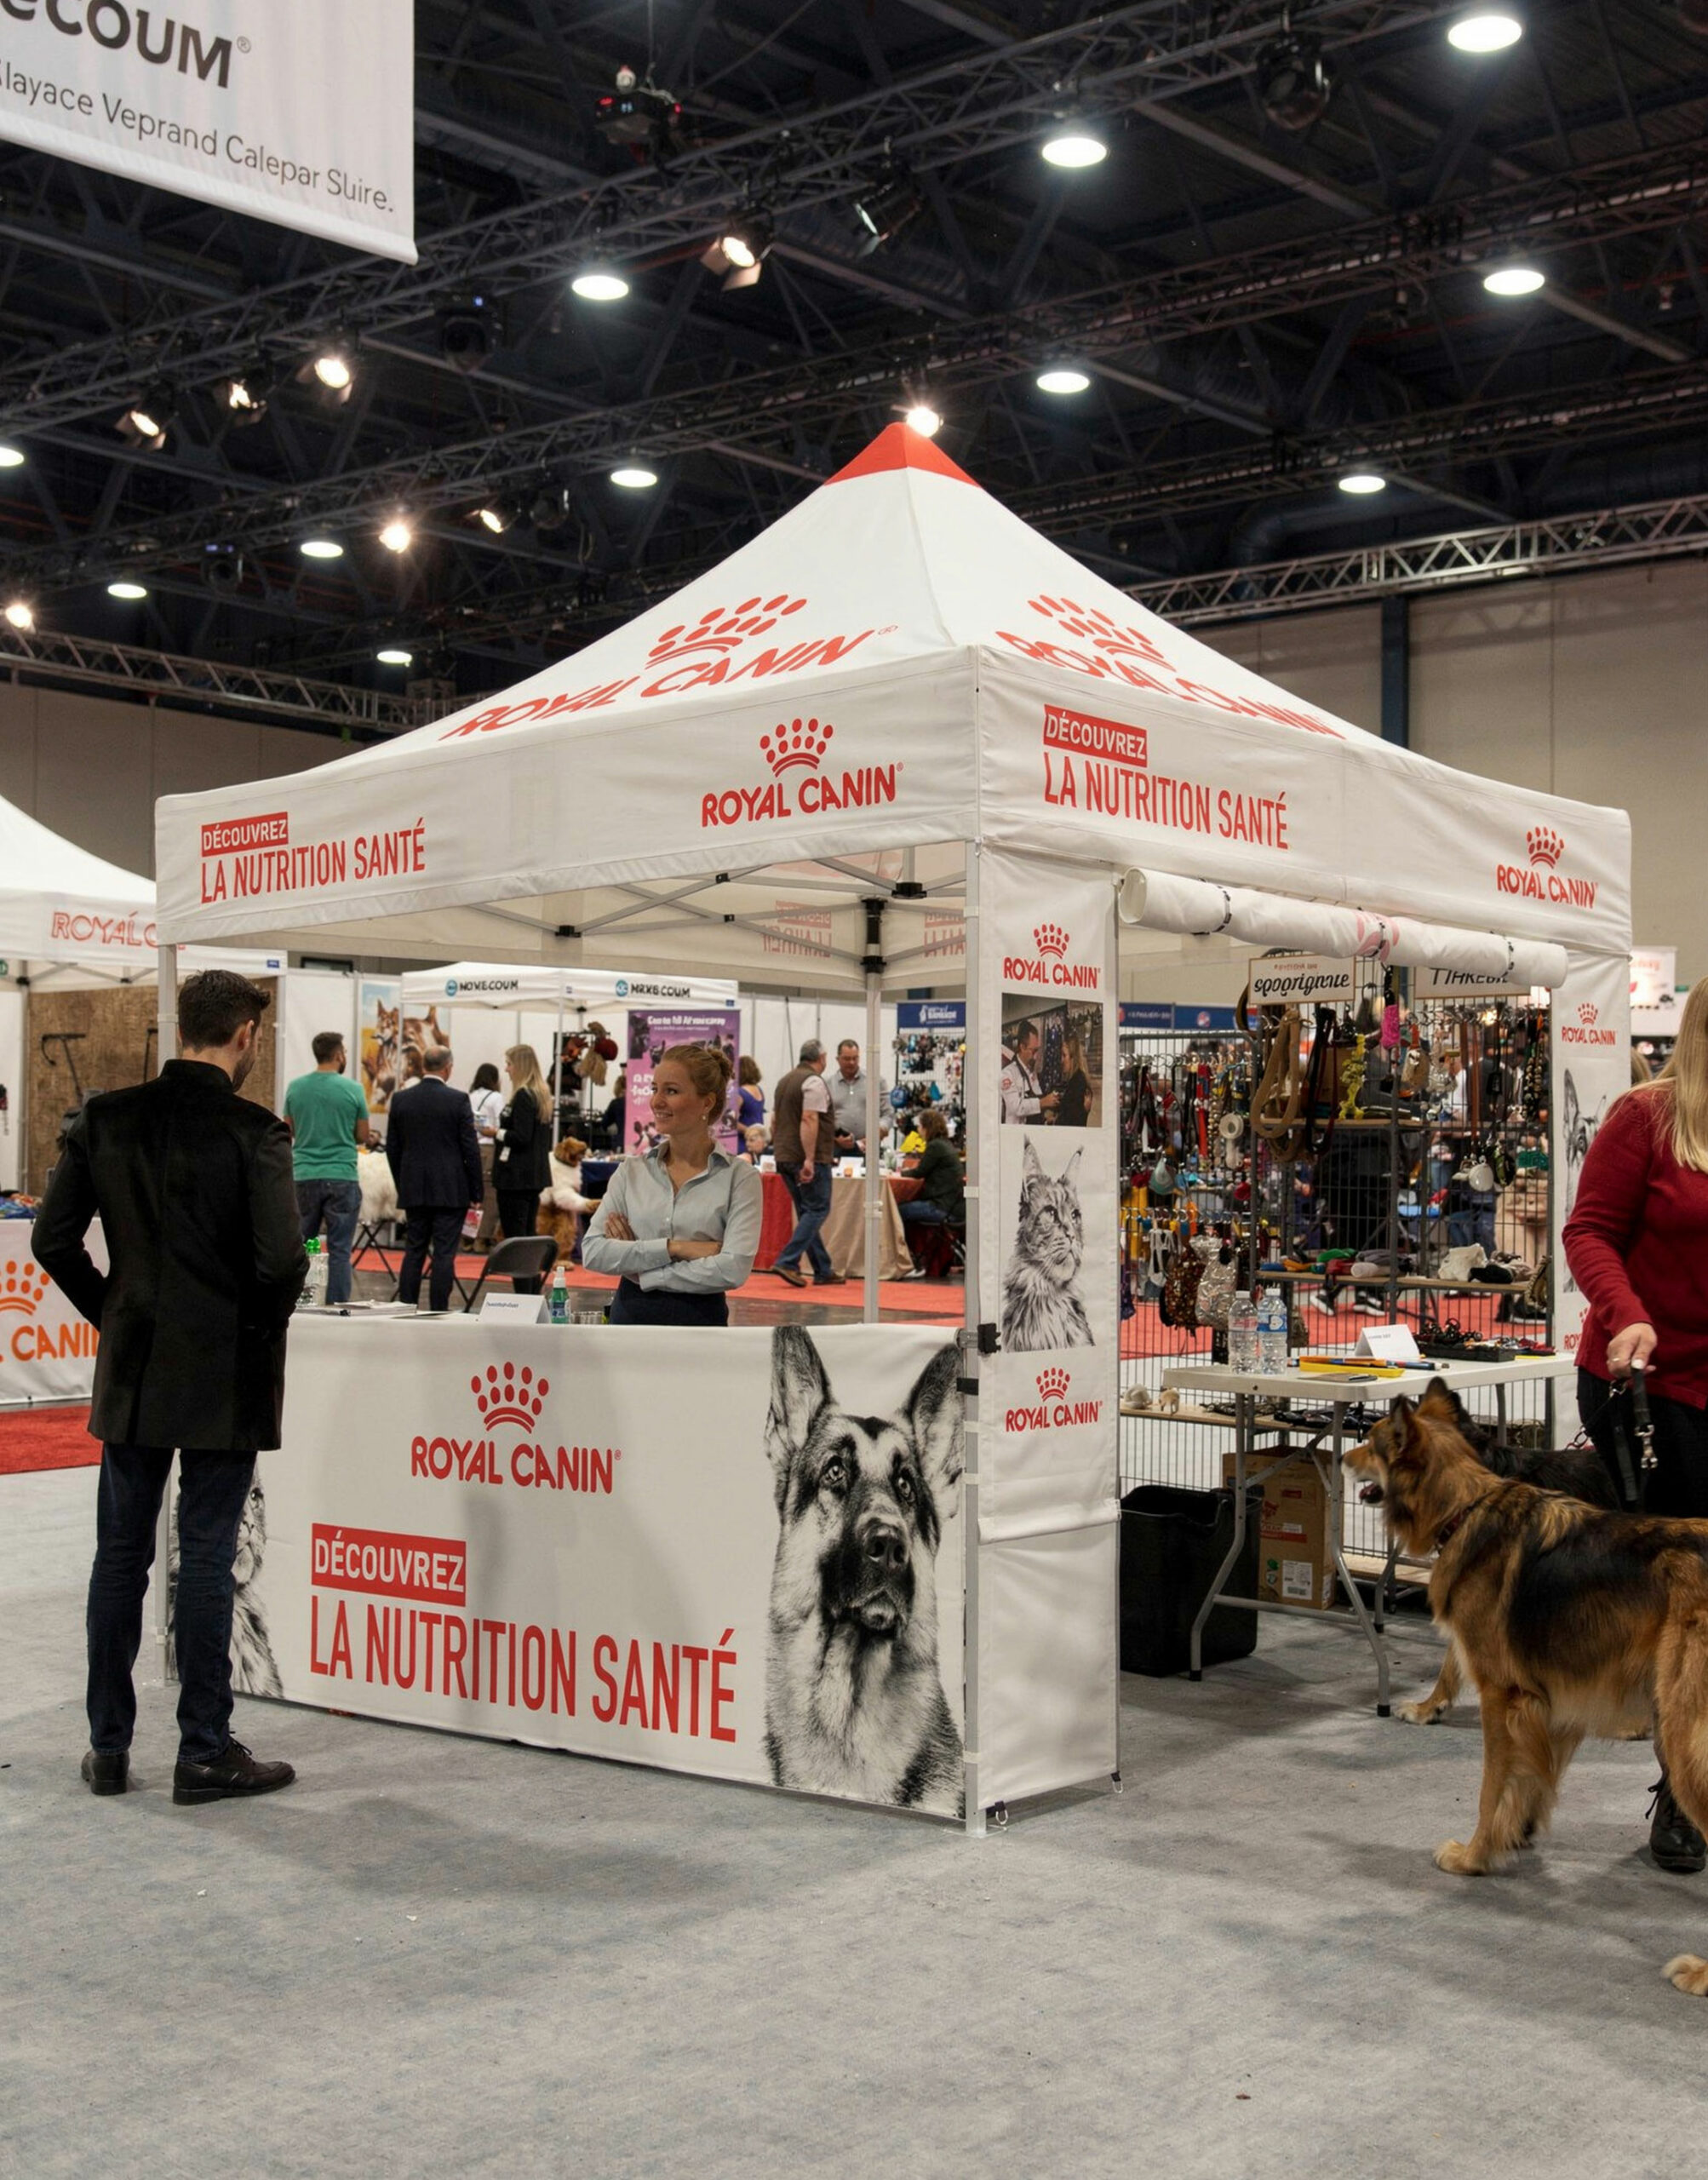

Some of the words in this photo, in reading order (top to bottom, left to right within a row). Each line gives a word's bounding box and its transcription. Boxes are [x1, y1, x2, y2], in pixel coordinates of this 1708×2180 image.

[102, 93, 218, 156] Veprand
[226, 135, 320, 188] Calepar
[438, 675, 640, 741] ROYAL
[1046, 711, 1146, 760] DÉCOUVREZ
[702, 783, 792, 828] ROYAL
[1043, 752, 1077, 808] LA
[1085, 760, 1211, 834] NUTRITION
[1218, 790, 1289, 850] SANTÉ
[203, 819, 288, 852] DÉCOUVREZ
[201, 860, 227, 904] LA
[233, 840, 347, 898] NUTRITION
[353, 818, 426, 881] SANTÉ
[1497, 863, 1546, 901] ROYAL
[1003, 956, 1050, 984] ROYAL
[1562, 1026, 1588, 1044] ROYAL
[1589, 1029, 1616, 1046] CANIN
[1006, 1406, 1051, 1432] ROYAL
[410, 1435, 504, 1485] ROYAL
[314, 1529, 465, 1593] DÉCOUVREZ
[310, 1595, 353, 1680] LA
[366, 1603, 577, 1718] NUTRITION
[591, 1627, 738, 1743] SANTÉ
